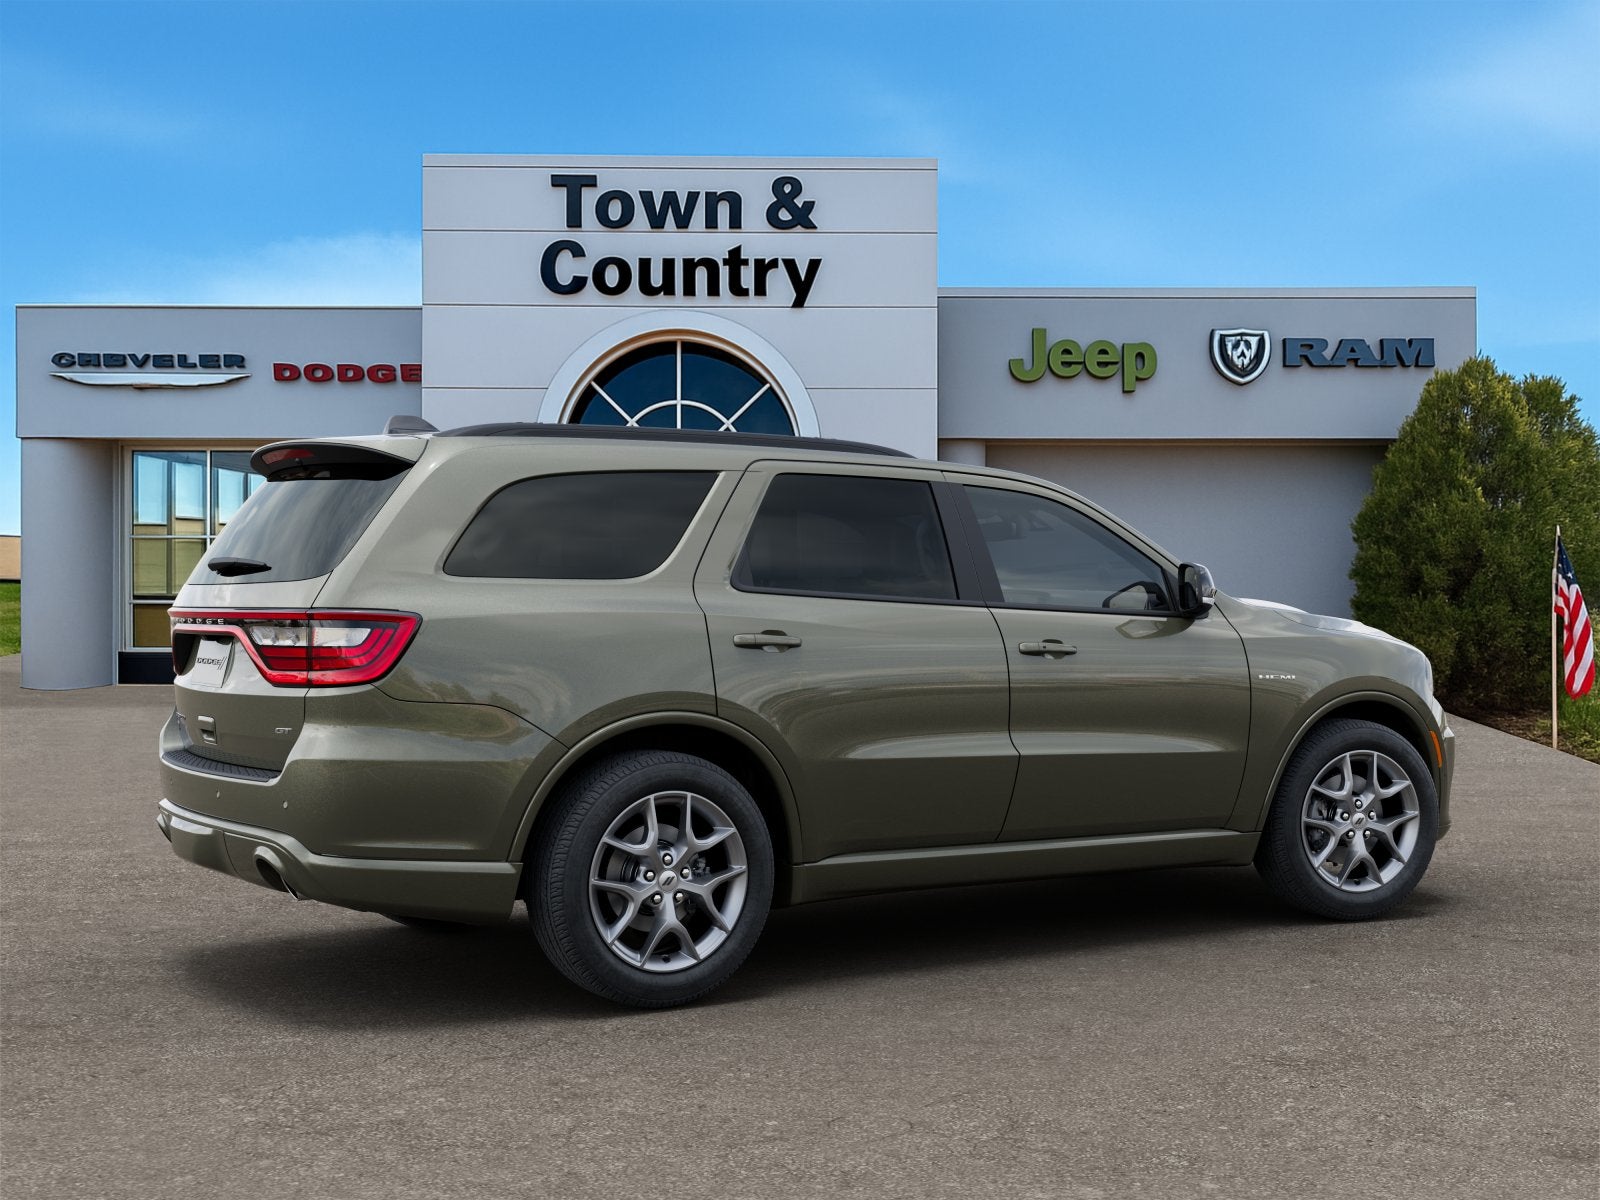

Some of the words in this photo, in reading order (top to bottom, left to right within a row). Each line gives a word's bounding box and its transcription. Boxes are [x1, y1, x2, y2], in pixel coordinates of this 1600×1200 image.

[550, 174, 743, 230] Town
[765, 175, 818, 231] &
[539, 239, 823, 309] Country
[1008, 327, 1158, 394] Jeep
[1282, 337, 1436, 368] RAM
[272, 362, 422, 384] DODGE
[1258, 673, 1297, 681] HEMI
[274, 727, 293, 735] GT
